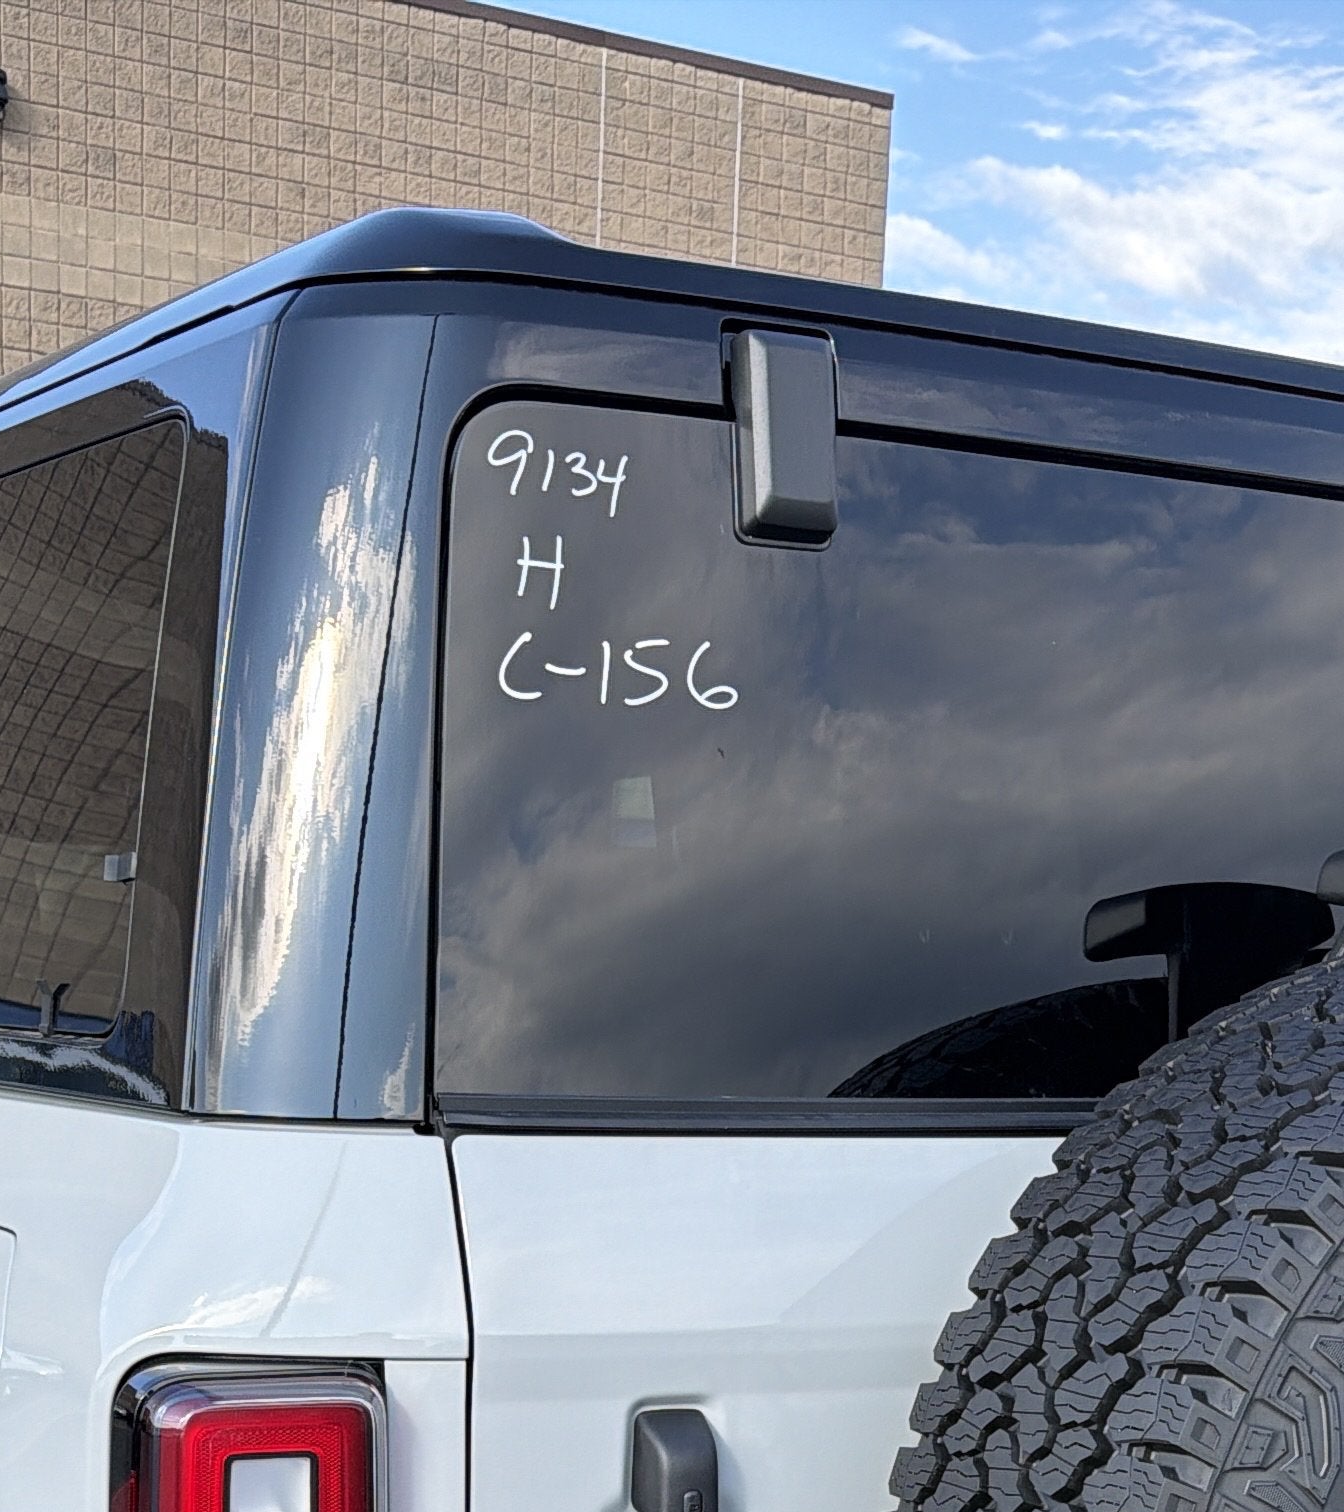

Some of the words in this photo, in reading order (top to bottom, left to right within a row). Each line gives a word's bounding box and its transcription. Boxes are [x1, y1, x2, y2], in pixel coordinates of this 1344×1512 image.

[487, 429, 628, 518] 9134
[516, 535, 565, 610] H
[498, 631, 739, 710] C-156
